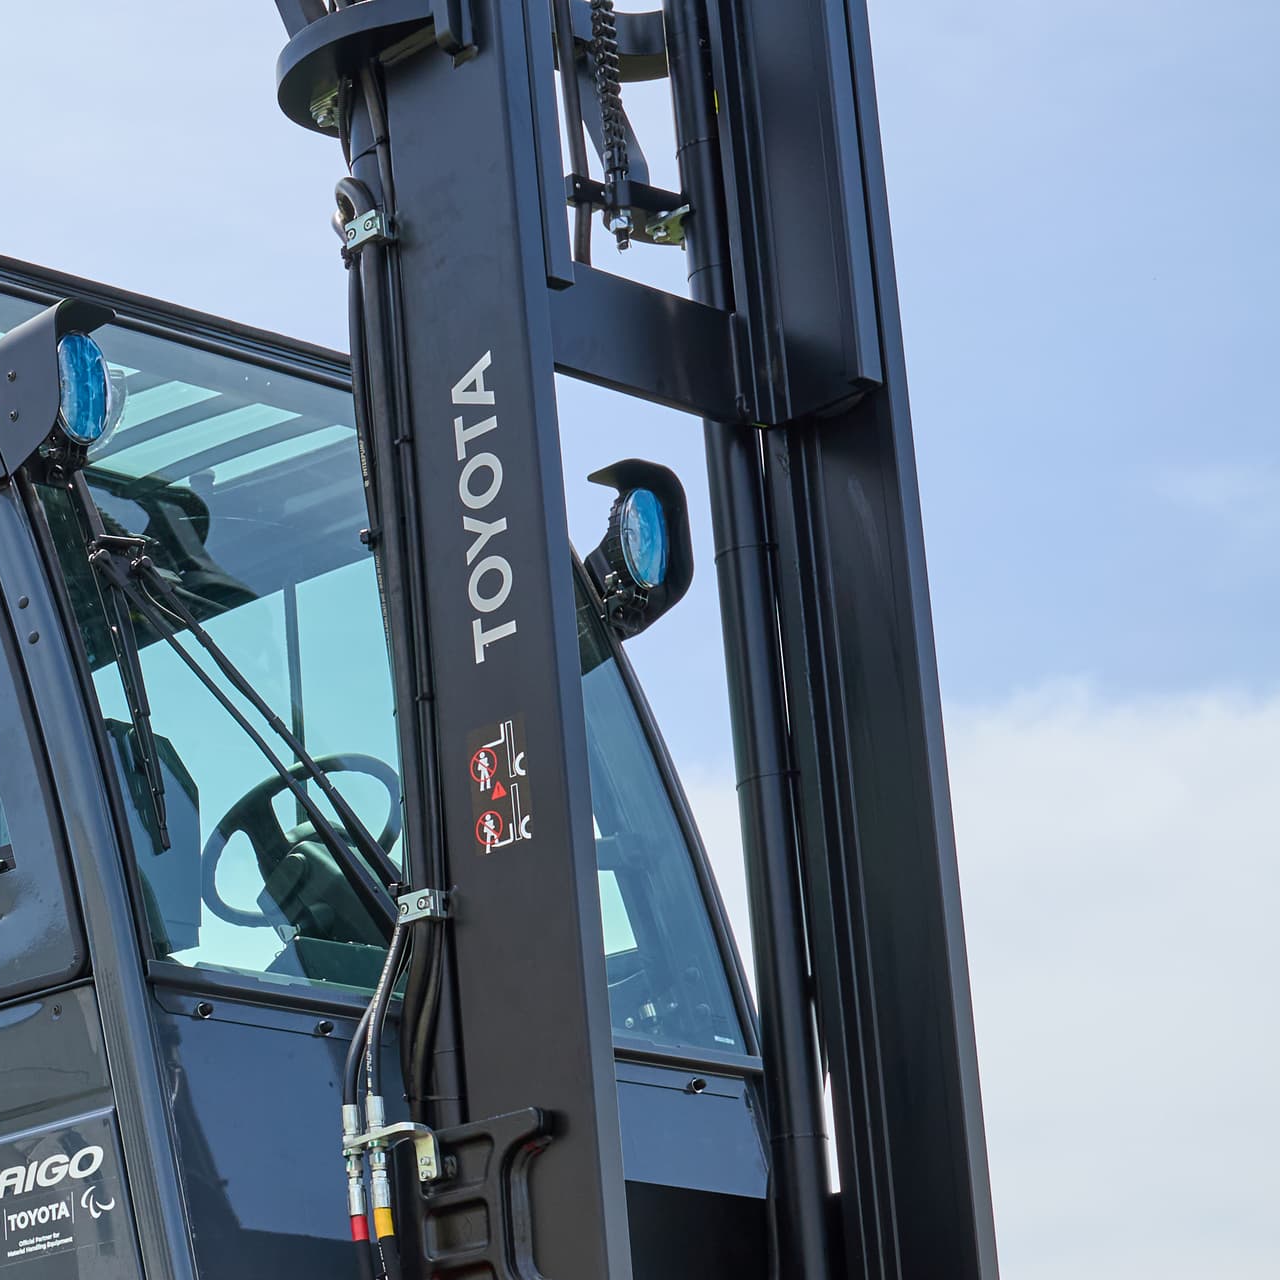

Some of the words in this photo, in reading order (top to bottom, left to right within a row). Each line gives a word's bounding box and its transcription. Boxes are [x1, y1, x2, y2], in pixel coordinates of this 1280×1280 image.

[451, 349, 517, 664] TOYOTA
[8, 1201, 70, 1232] TOYOTA
[7, 1246, 25, 1258] Material
[25, 1242, 47, 1253] Handling
[46, 1236, 73, 1249] Equipment
[18, 1236, 35, 1247] Official
[35, 1233, 53, 1243] Partner
